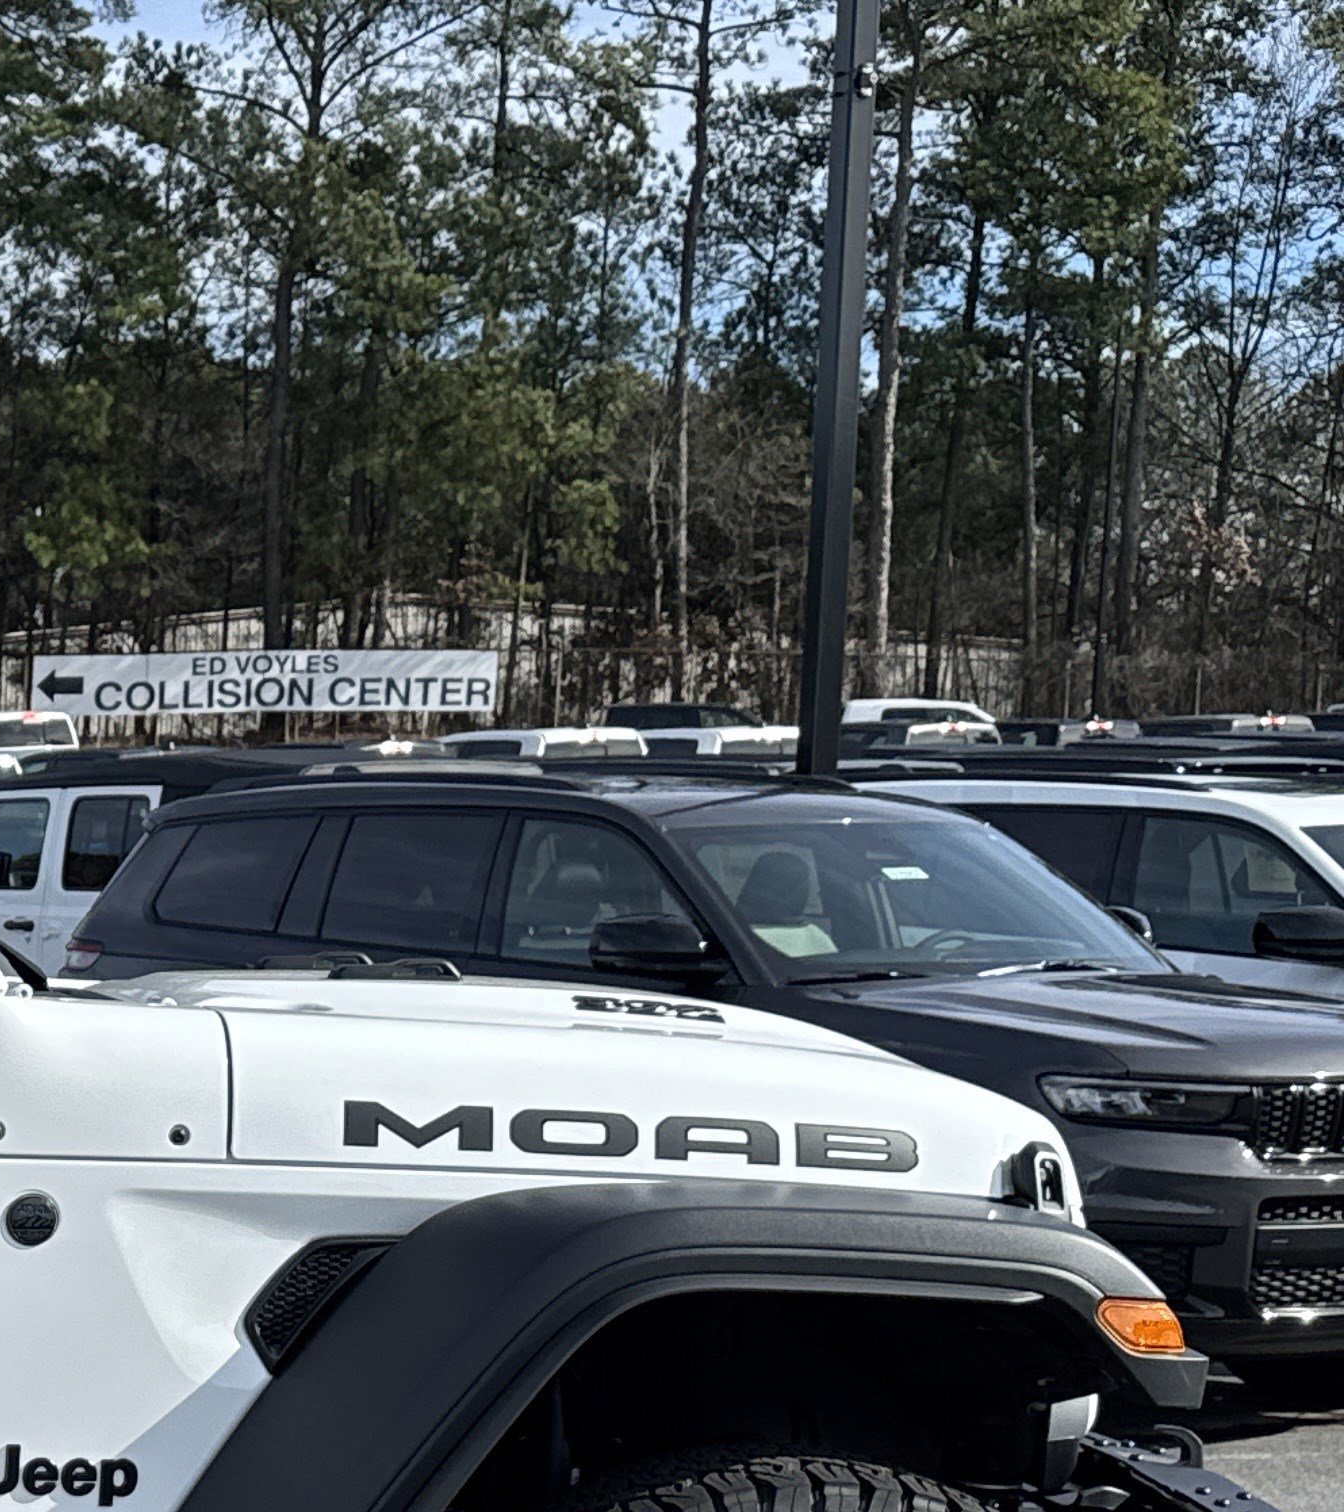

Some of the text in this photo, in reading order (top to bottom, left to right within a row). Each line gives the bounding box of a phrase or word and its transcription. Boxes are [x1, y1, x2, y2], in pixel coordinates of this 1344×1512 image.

[192, 654, 340, 676] ED VOYLES
[95, 676, 492, 711] COLLISION CENTER
[343, 1100, 920, 1173] MOAB
